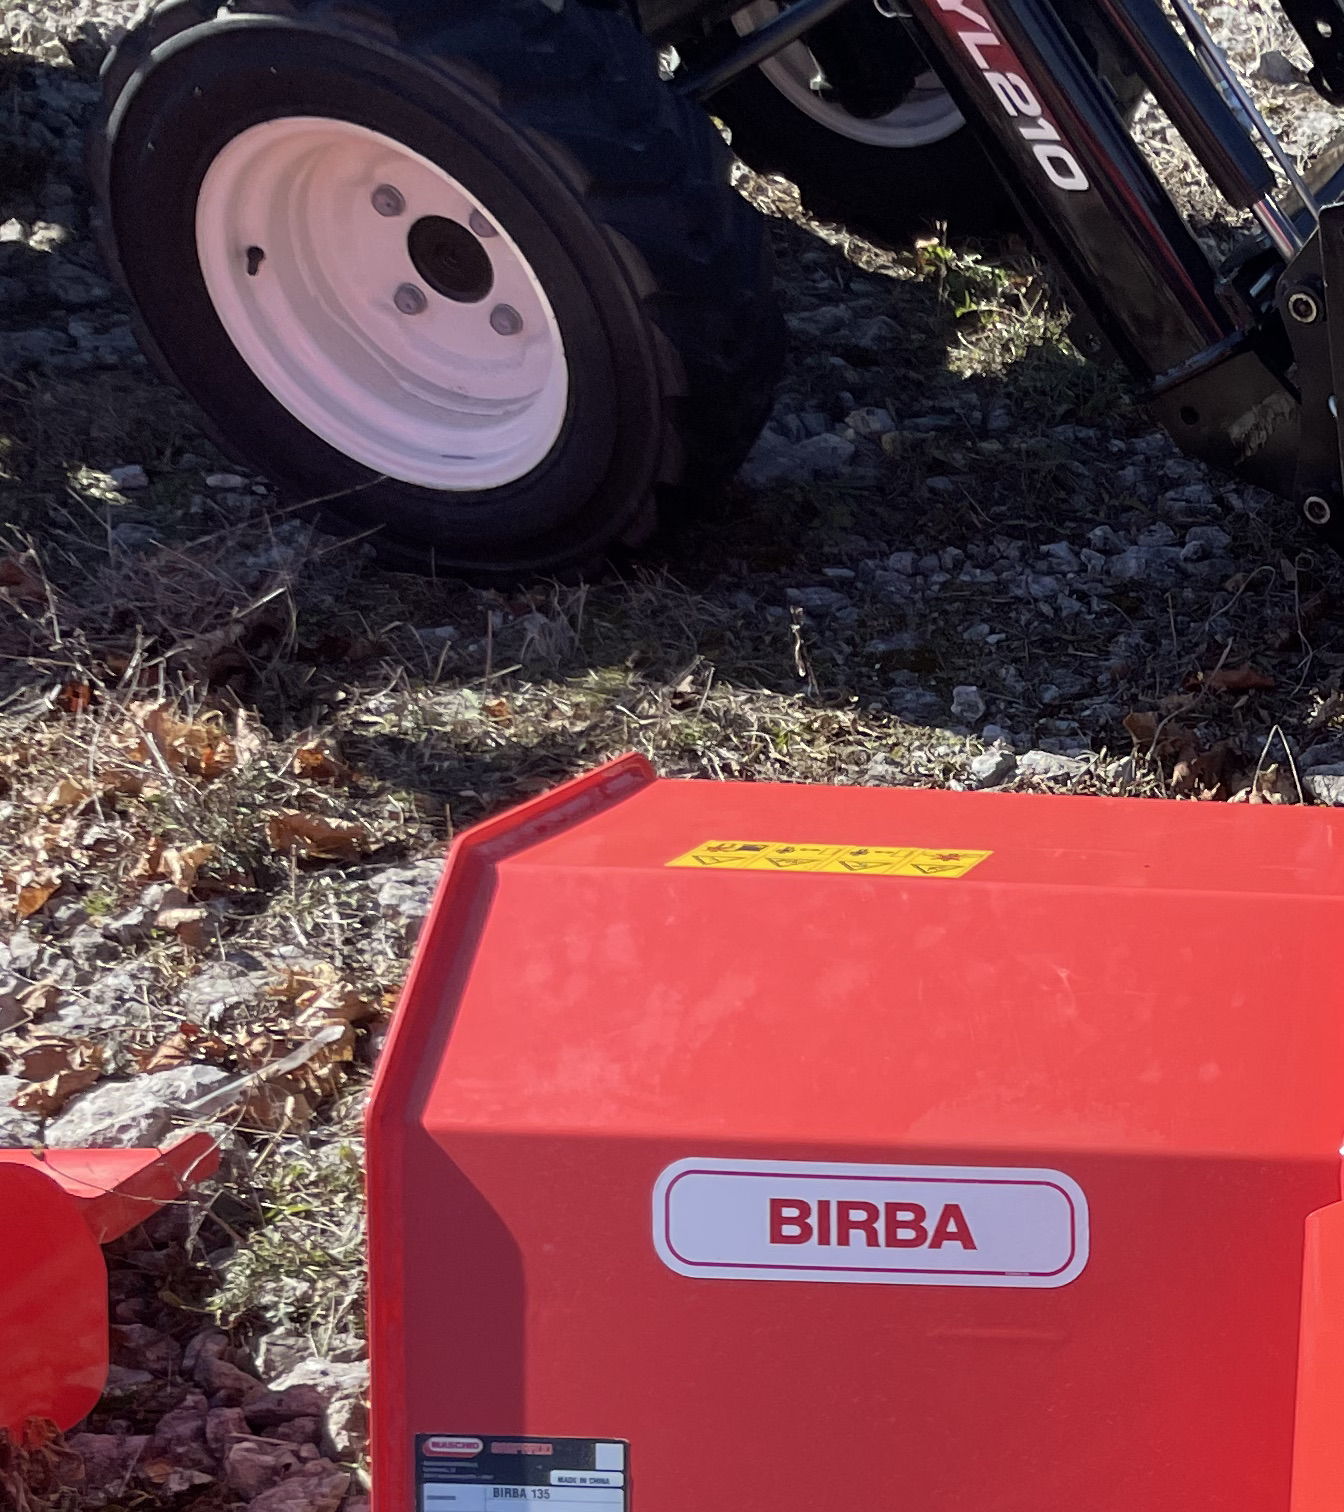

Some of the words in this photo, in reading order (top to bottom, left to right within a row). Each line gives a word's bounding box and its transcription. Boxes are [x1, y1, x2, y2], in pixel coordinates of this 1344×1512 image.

[768, 1197, 978, 1251] BIRBA
[493, 1487, 527, 1498] BIRBA
[531, 1488, 550, 1499] 135
